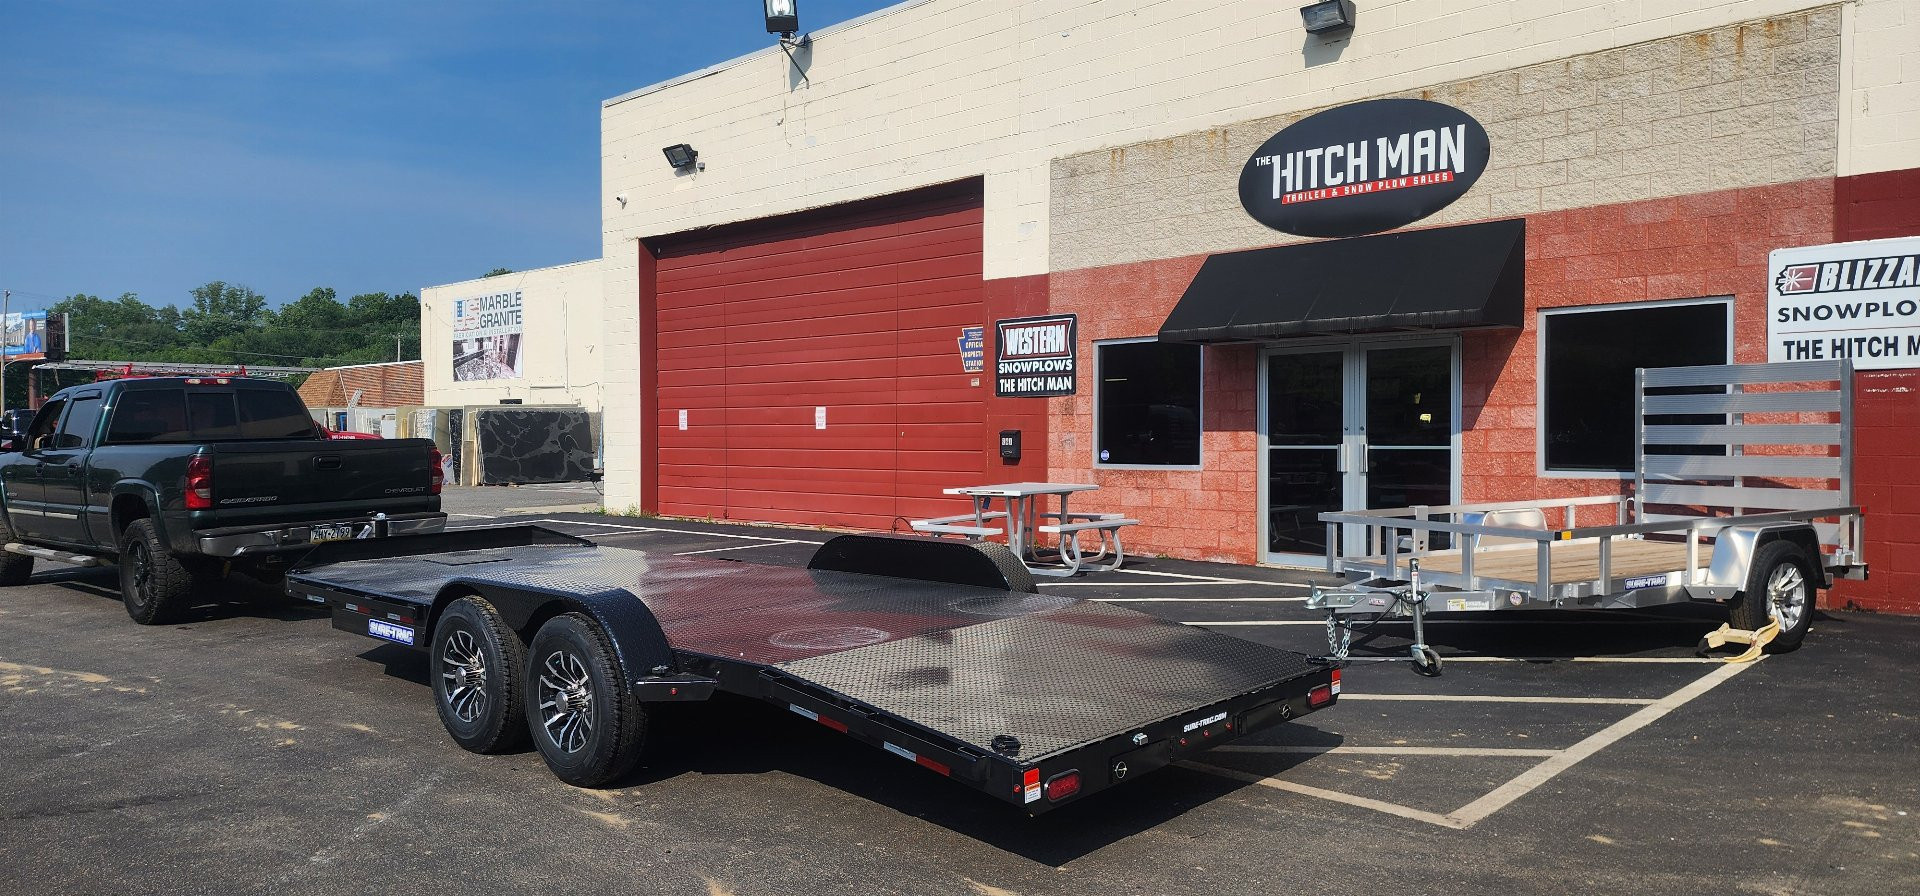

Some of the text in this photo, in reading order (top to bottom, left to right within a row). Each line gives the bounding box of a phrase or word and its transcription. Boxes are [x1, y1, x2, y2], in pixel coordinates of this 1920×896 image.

[1255, 123, 1465, 199] THE HITCH MAN
[1286, 172, 1449, 203] TRAILER & SNOW PLOW SALES
[1818, 256, 1920, 292] BLIZZA
[480, 291, 521, 311] MARBLE
[1777, 299, 1920, 323] SNOWPLO
[480, 310, 521, 328] GRANITE
[965, 341, 983, 349] OFFICIA
[1005, 325, 1066, 356] WESTERN
[1783, 339, 1823, 360] THE
[1831, 336, 1898, 359] HITCH
[998, 359, 1073, 374] SNOWPLOWS
[999, 376, 1072, 393] THE HITCH MAN
[384, 486, 426, 494] CHEVROLET
[1625, 576, 1666, 589] SURE-TRAC
[369, 620, 413, 643] SURE-TRAC
[1183, 711, 1228, 733] SURE-TRAC.COM
